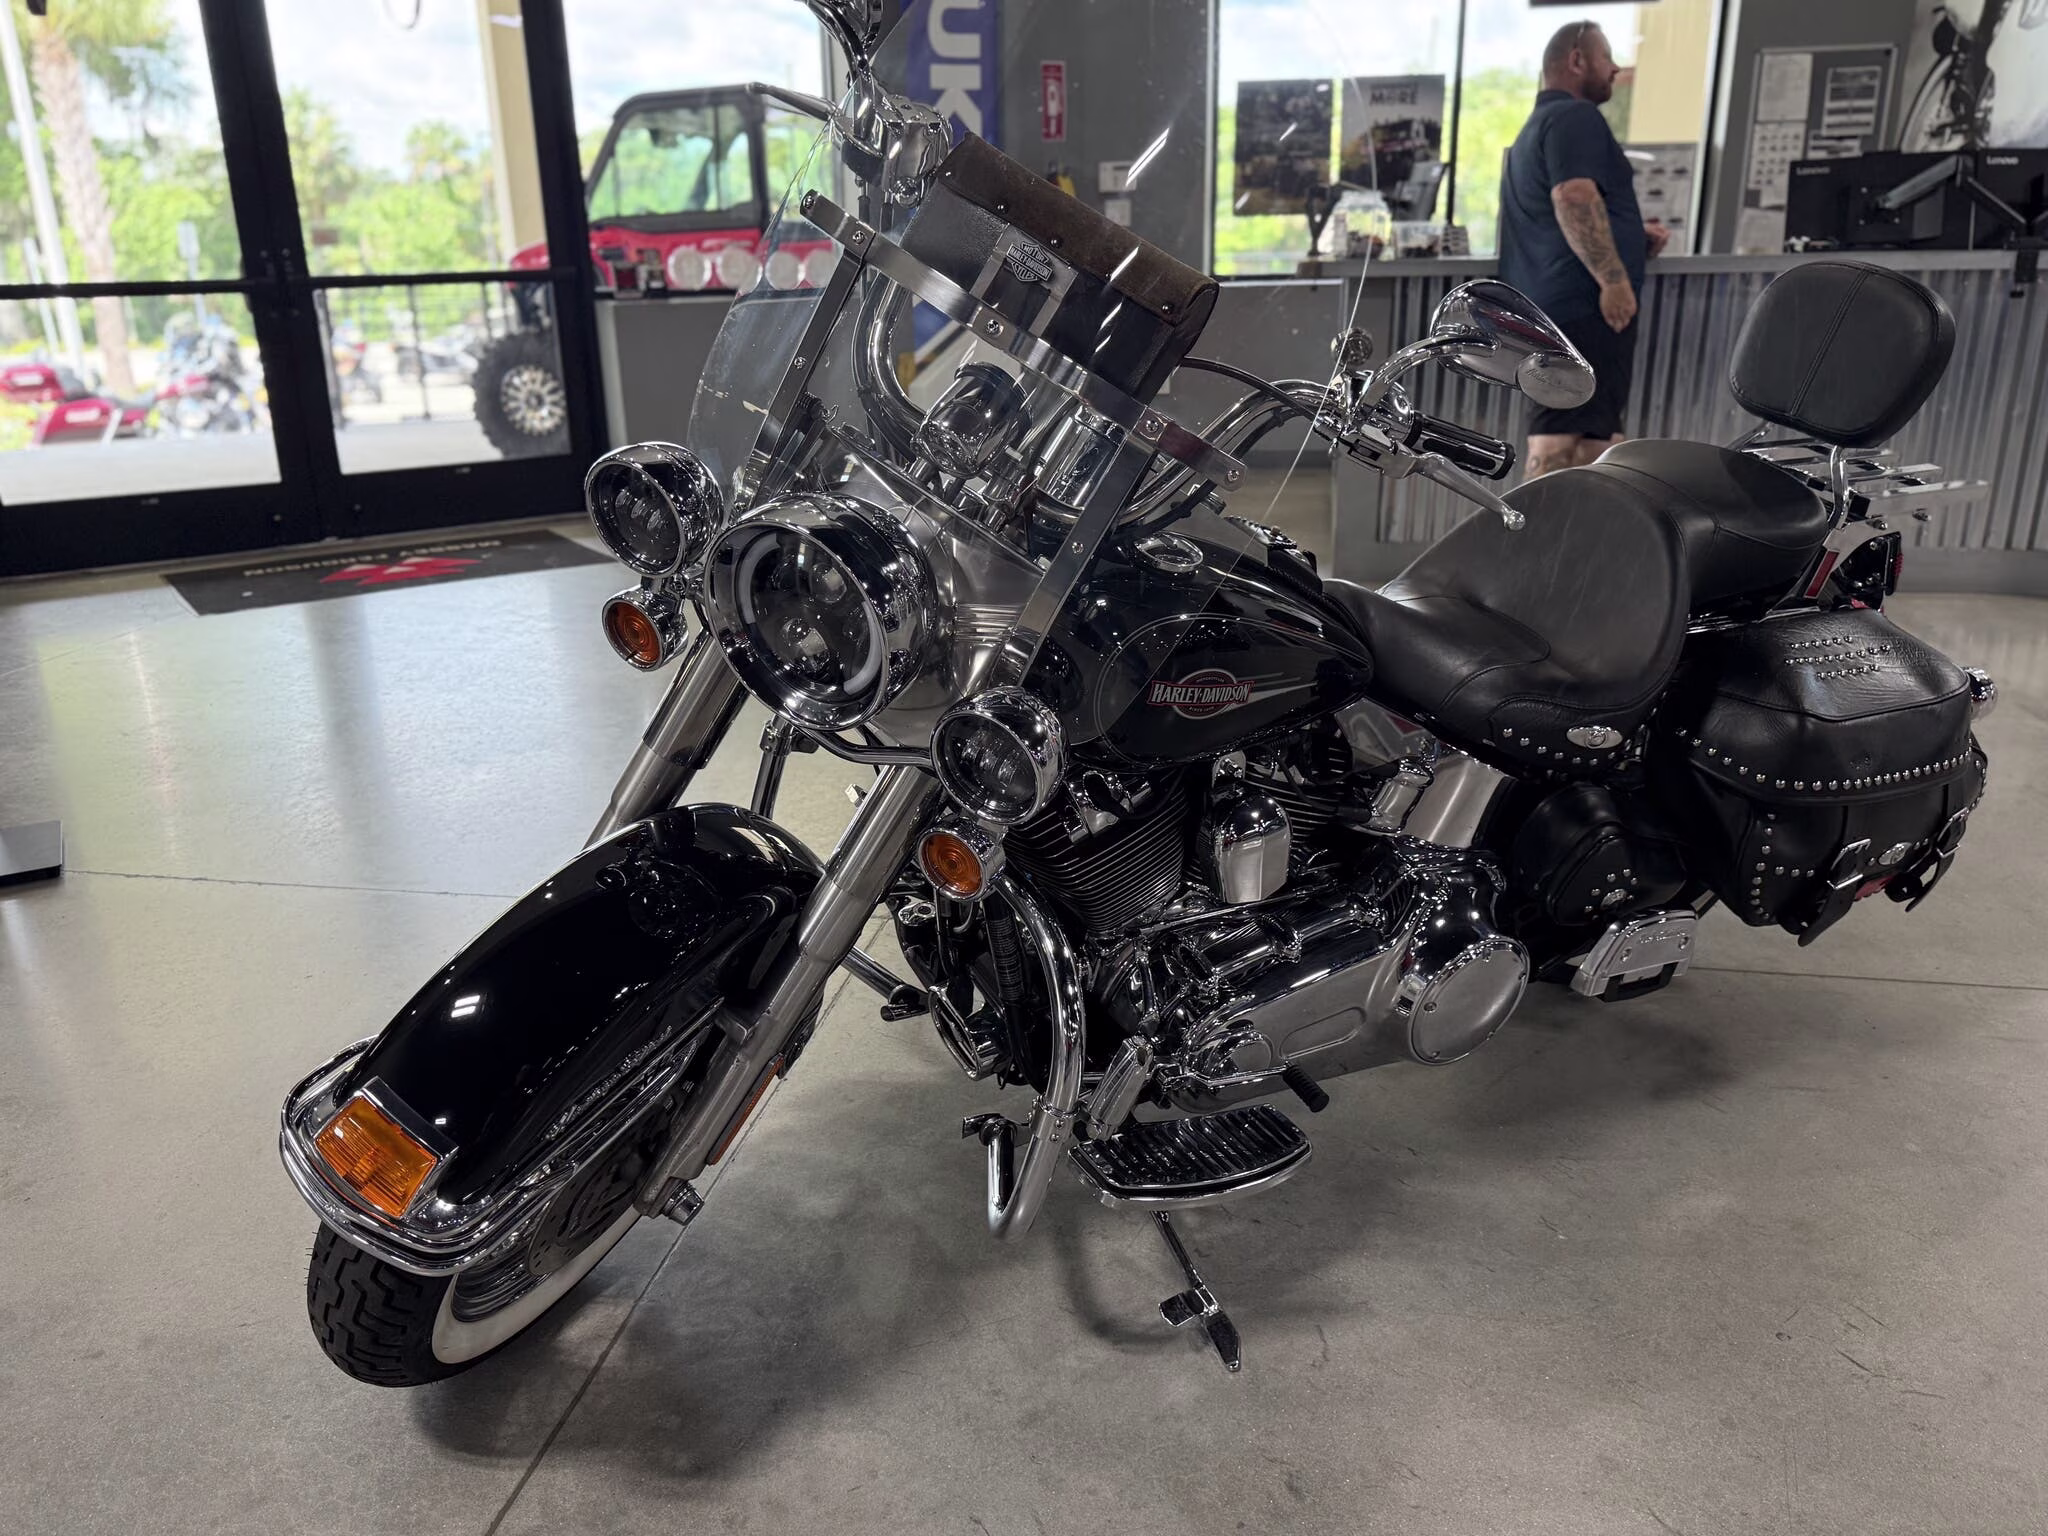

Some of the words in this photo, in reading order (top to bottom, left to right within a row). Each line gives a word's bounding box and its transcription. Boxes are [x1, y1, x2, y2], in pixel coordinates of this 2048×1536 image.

[1986, 155, 2019, 166] Lenovo
[1796, 166, 1831, 176] Lenovo
[1022, 245, 1046, 263] MOTOR
[1151, 683, 1250, 703] HARLEY-DAVIDSON
